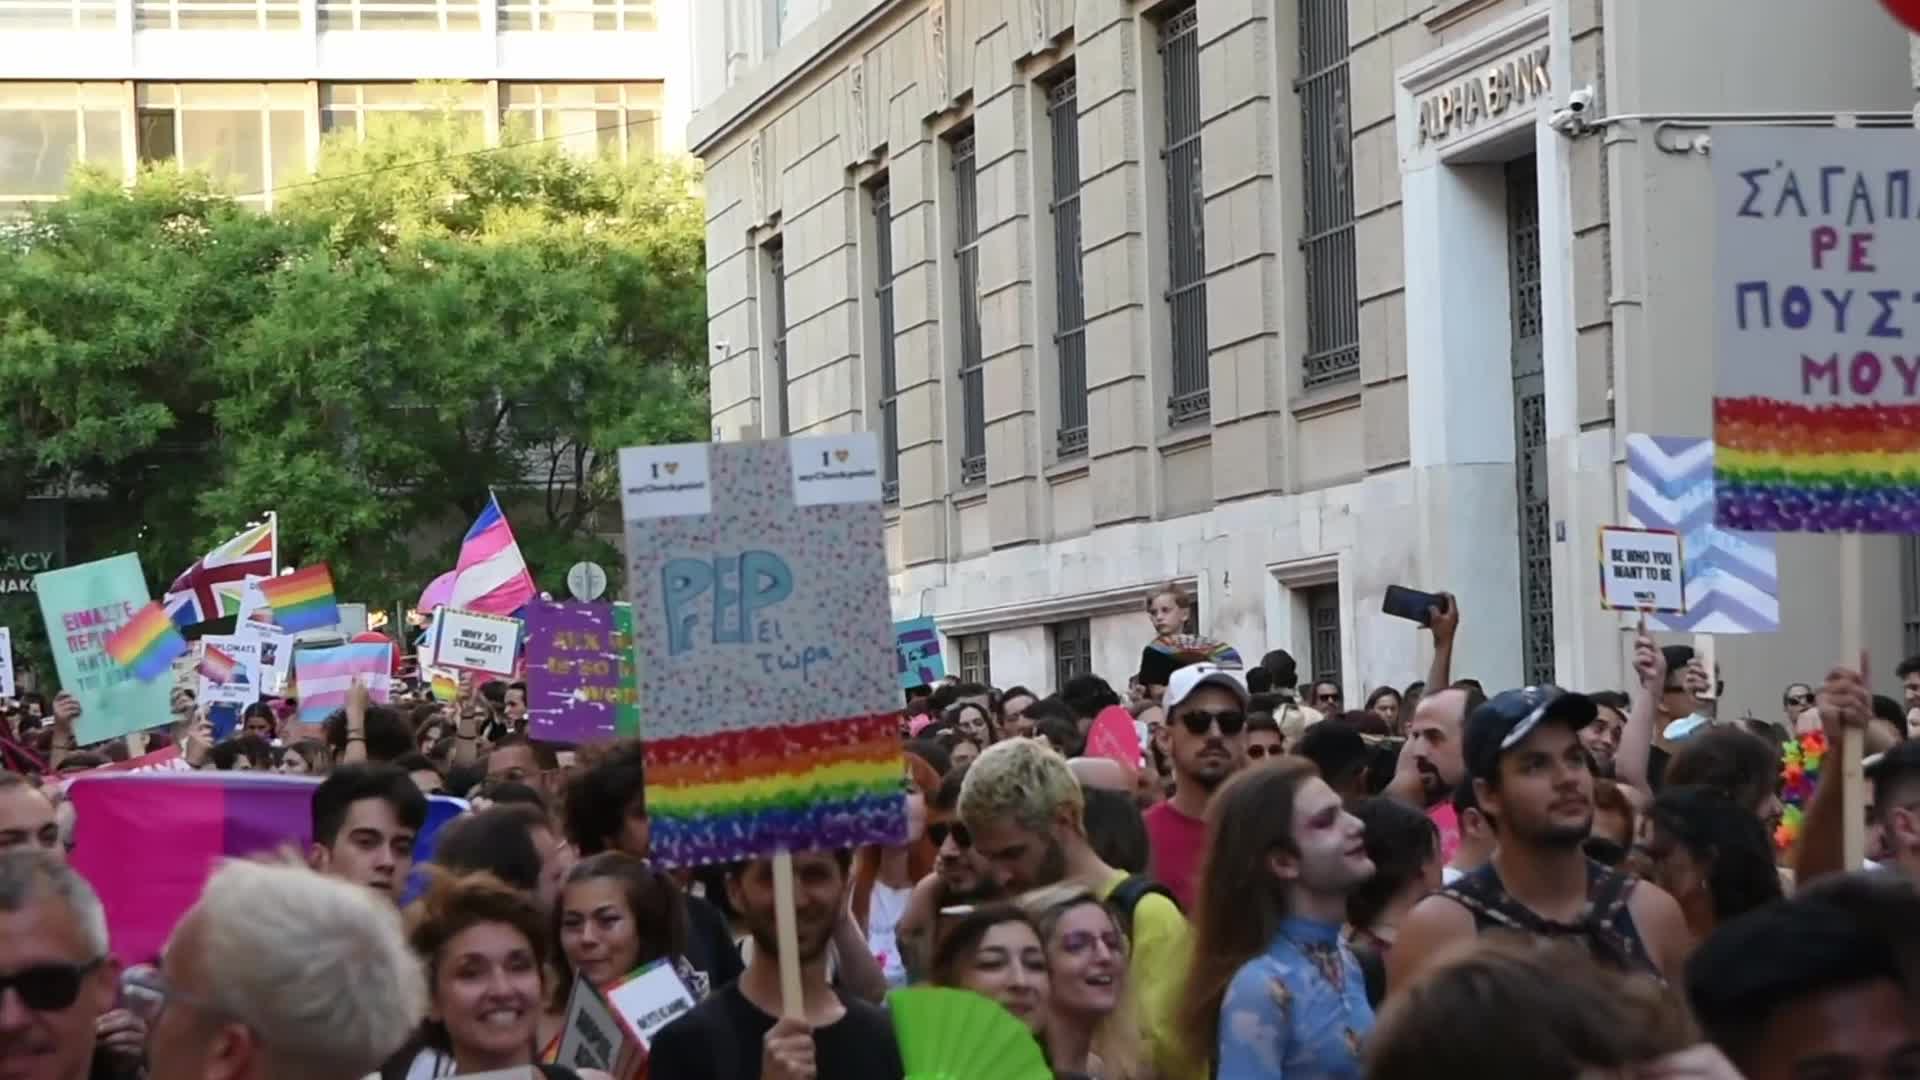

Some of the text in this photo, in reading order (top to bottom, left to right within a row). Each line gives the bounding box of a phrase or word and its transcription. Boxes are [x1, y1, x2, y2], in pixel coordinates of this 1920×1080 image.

[1418, 45, 1552, 146] ALPHA BANK
[1735, 280, 1920, 339] ΠΟΥΣ
[1611, 548, 1673, 566] BE WHO YOU
[1613, 565, 1673, 582] WANT TO BE
[461, 628, 498, 642] WHY SO
[453, 638, 503, 654] STRAIGHT?
